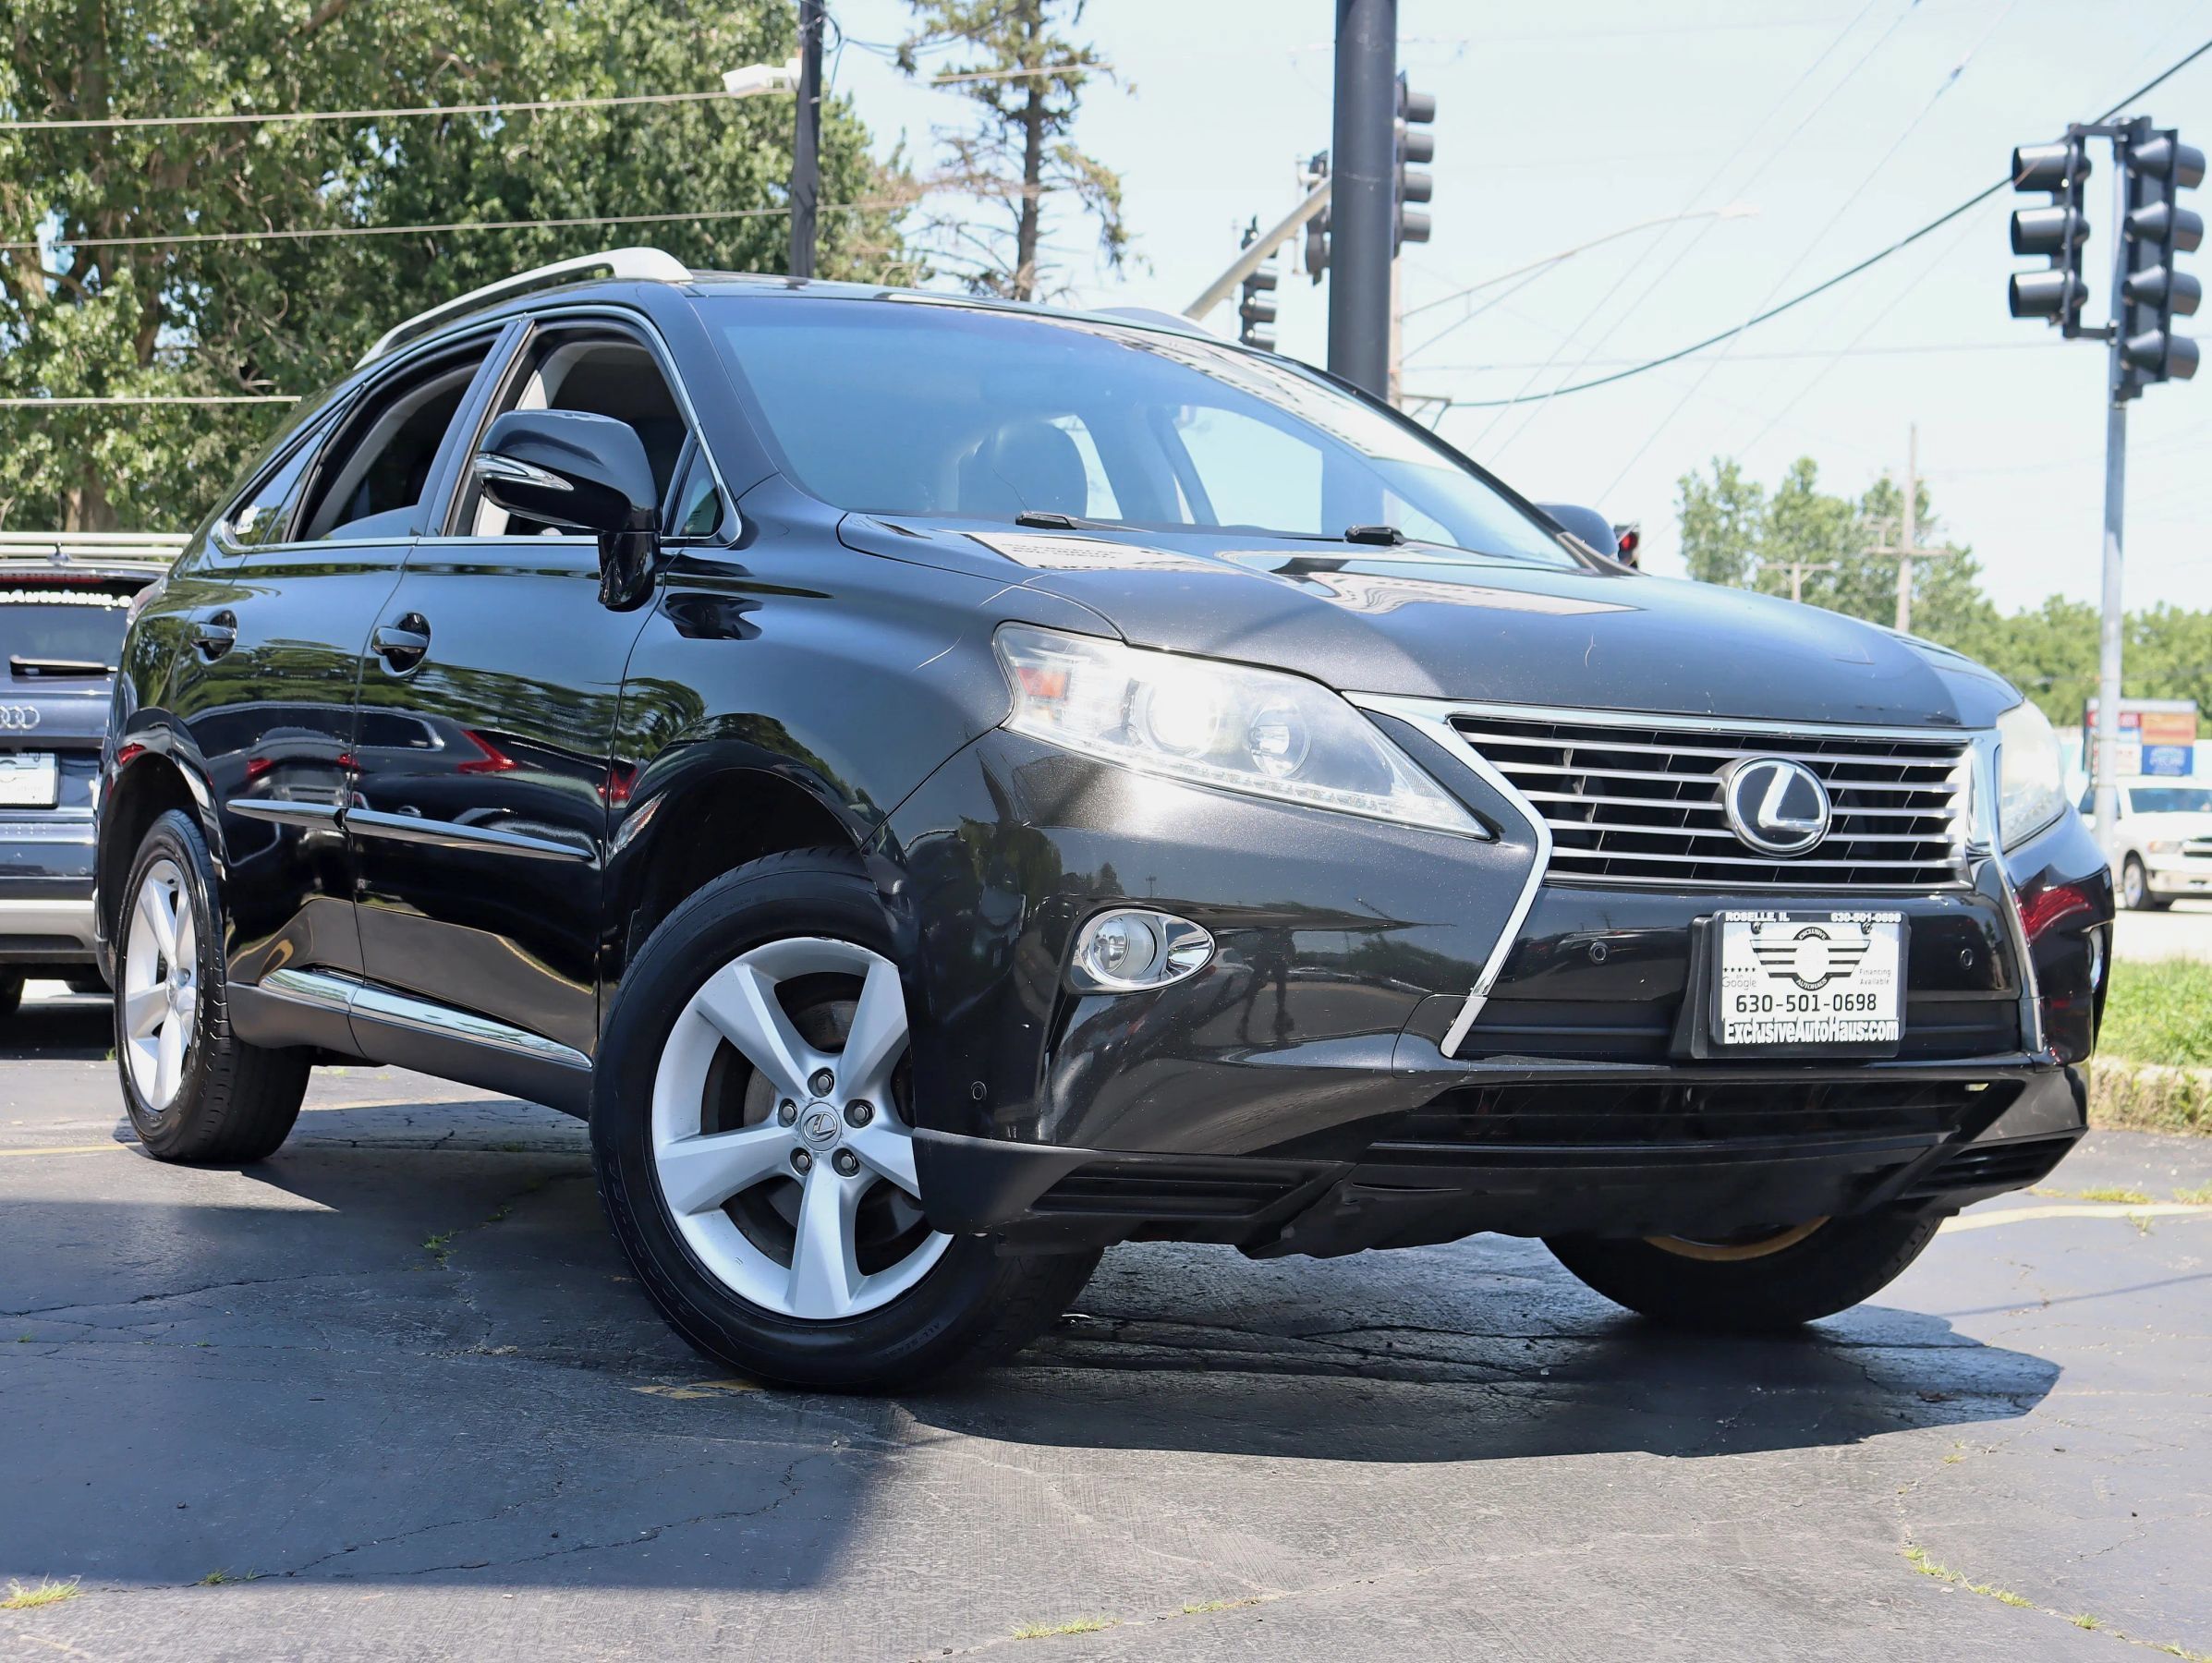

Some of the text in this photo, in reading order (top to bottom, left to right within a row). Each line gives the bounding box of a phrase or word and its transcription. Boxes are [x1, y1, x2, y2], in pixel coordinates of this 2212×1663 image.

[1778, 911, 1791, 922] IL
[1830, 912, 1902, 923] 630-501-0698
[1722, 976, 1756, 991] Google
[1796, 977, 1828, 990] AUTOHAUS
[1736, 993, 1877, 1014] 630-501-0698
[1724, 1015, 1900, 1044] ExclusiveAutoHaus.com
